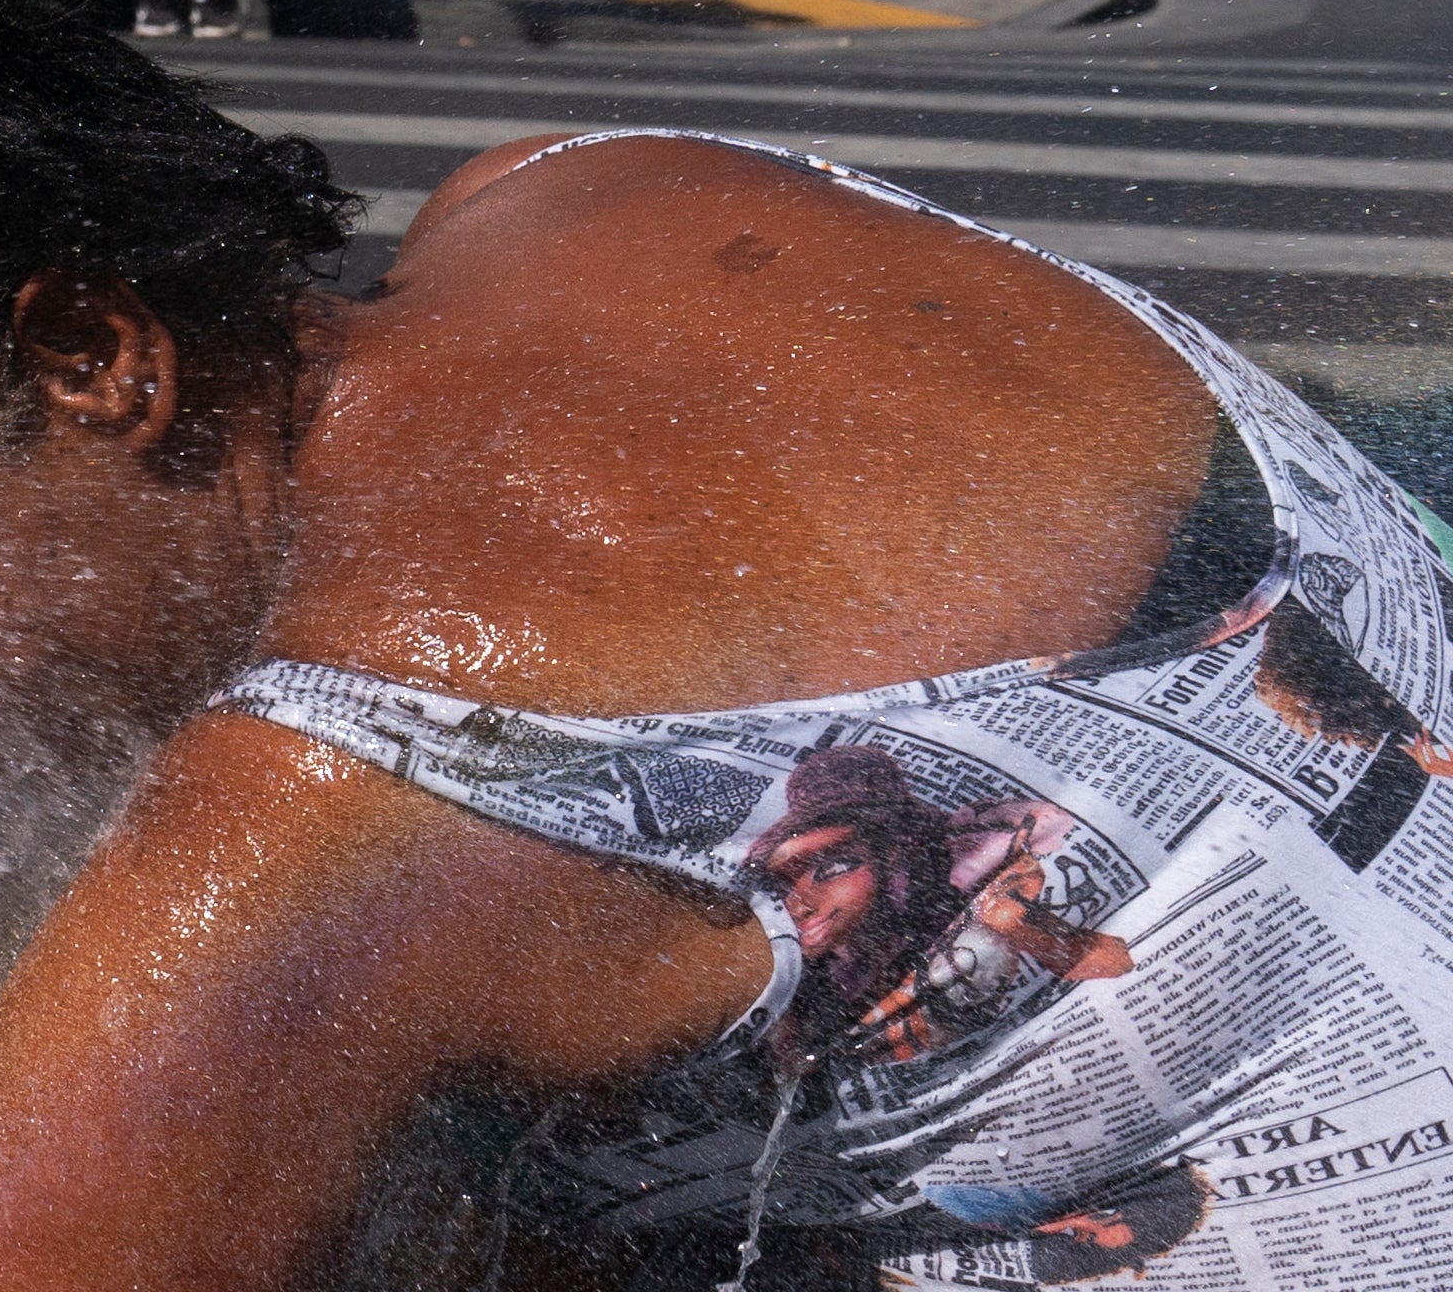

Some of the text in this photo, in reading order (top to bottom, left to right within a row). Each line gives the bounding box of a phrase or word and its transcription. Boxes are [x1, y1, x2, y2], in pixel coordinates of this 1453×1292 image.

[1418, 622, 1438, 720] Spezialhaus
[1145, 674, 1199, 725] Fort
[1233, 716, 1266, 748] stiefel
[469, 792, 587, 840] Potsdamer
